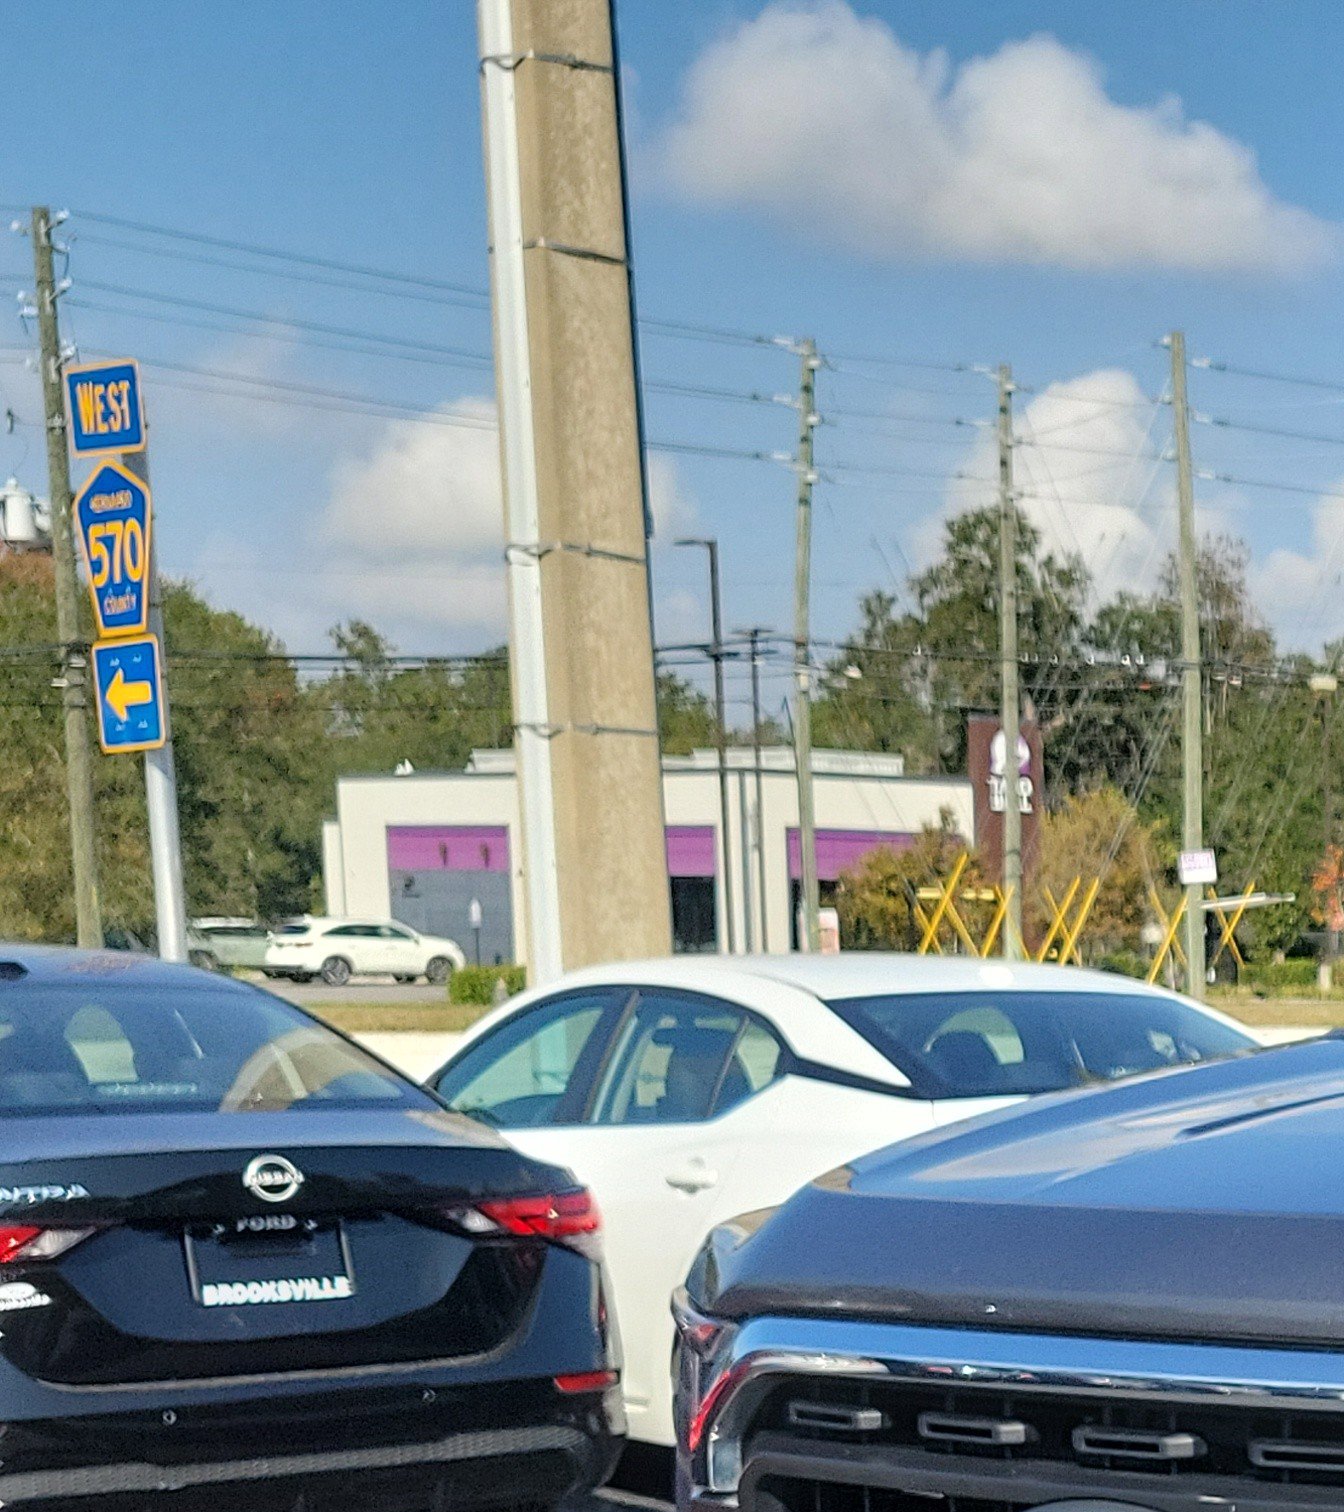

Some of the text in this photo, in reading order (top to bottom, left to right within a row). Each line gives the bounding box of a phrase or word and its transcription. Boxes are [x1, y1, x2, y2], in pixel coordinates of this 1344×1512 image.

[76, 380, 131, 435] WEST
[88, 517, 144, 588] 570
[236, 1214, 298, 1232] FORD
[202, 1275, 354, 1306] BROOKSVILLE
